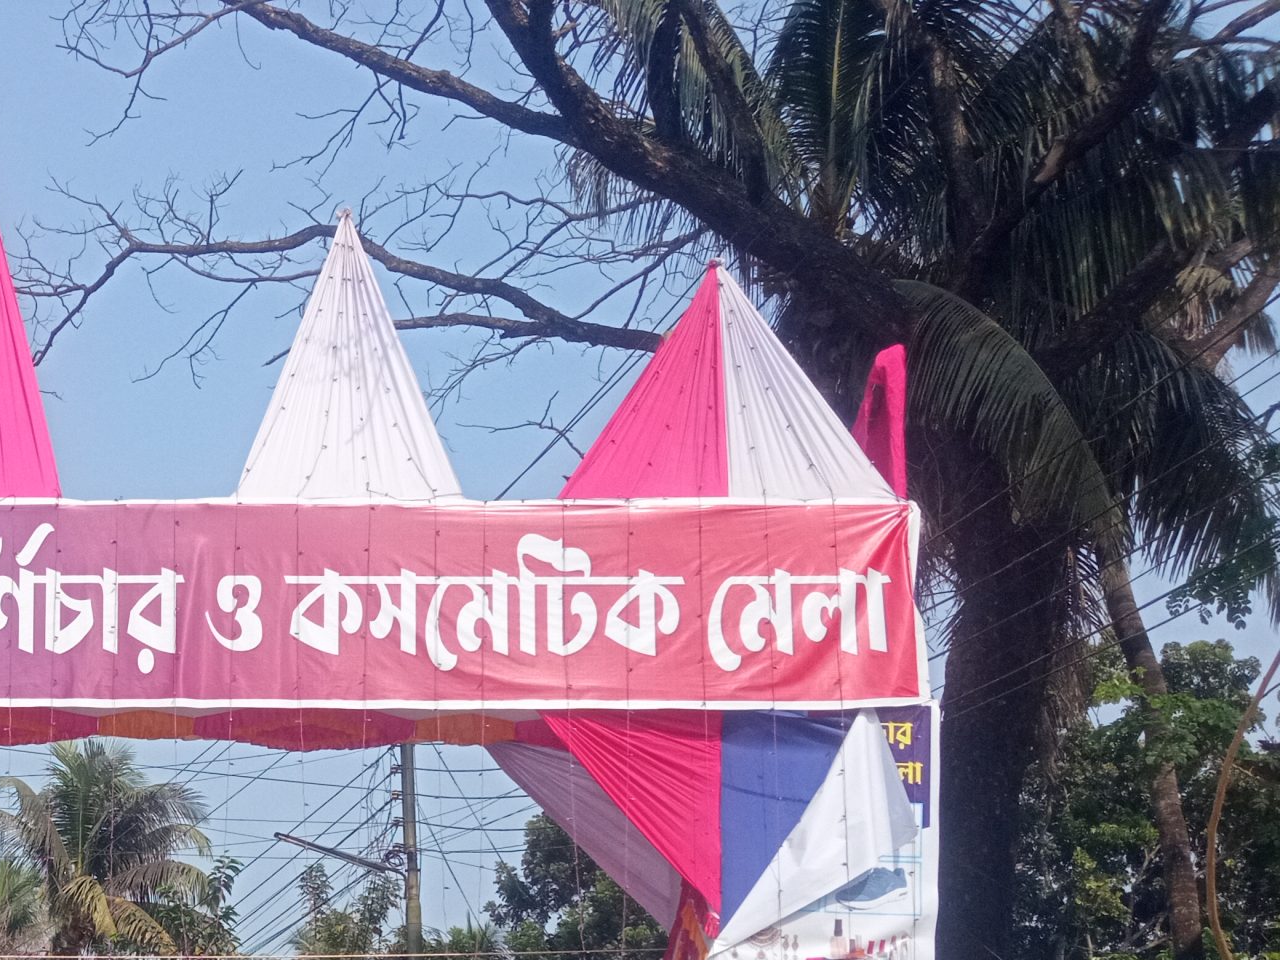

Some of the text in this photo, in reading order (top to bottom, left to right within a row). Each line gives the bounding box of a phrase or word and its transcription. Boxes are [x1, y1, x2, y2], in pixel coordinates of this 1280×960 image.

[205, 575, 263, 652] ও
[283, 533, 685, 671] কসমেটিক
[707, 567, 891, 672] মেলা
